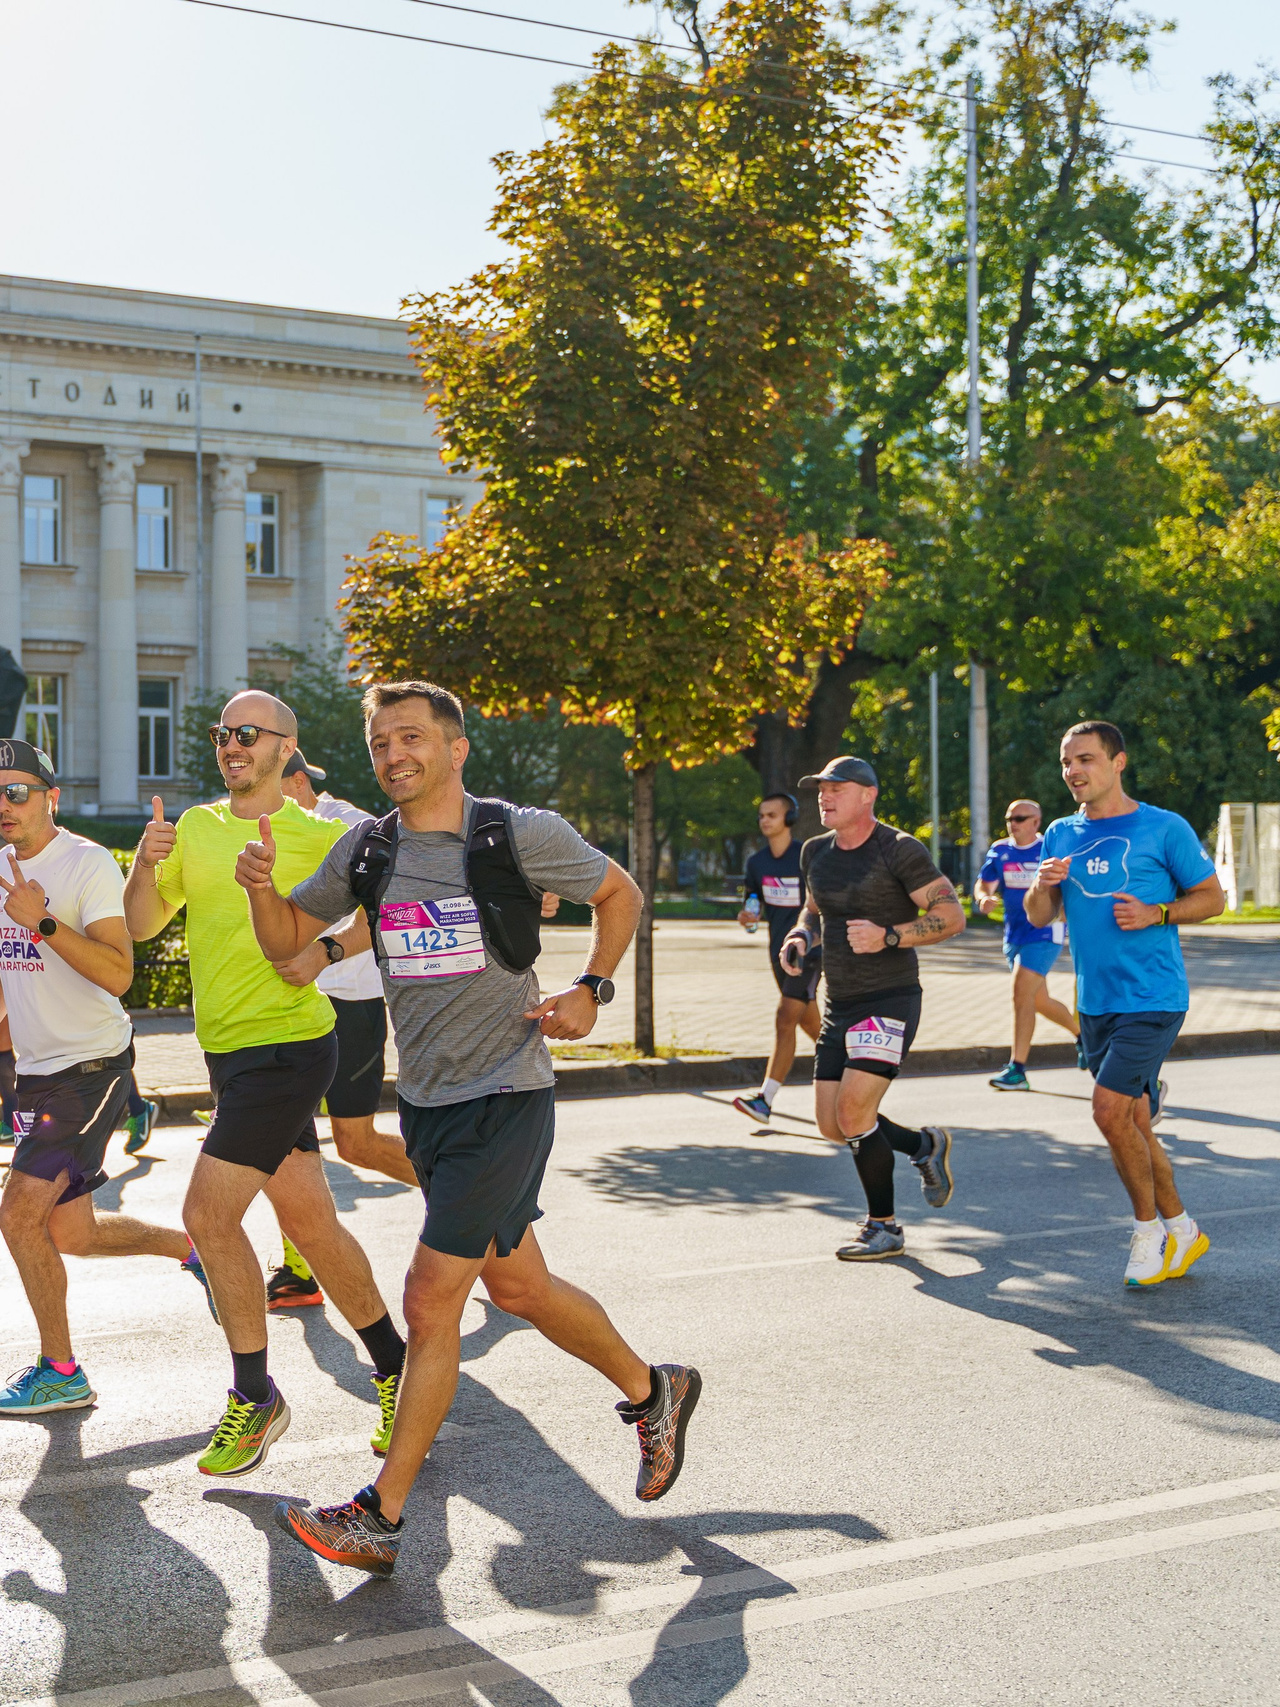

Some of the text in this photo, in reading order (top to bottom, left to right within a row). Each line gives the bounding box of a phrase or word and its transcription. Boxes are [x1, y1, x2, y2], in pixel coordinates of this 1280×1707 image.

[1086, 856, 1110, 876] tis
[401, 928, 458, 952] 1423
[858, 1032, 892, 1046] 1267
